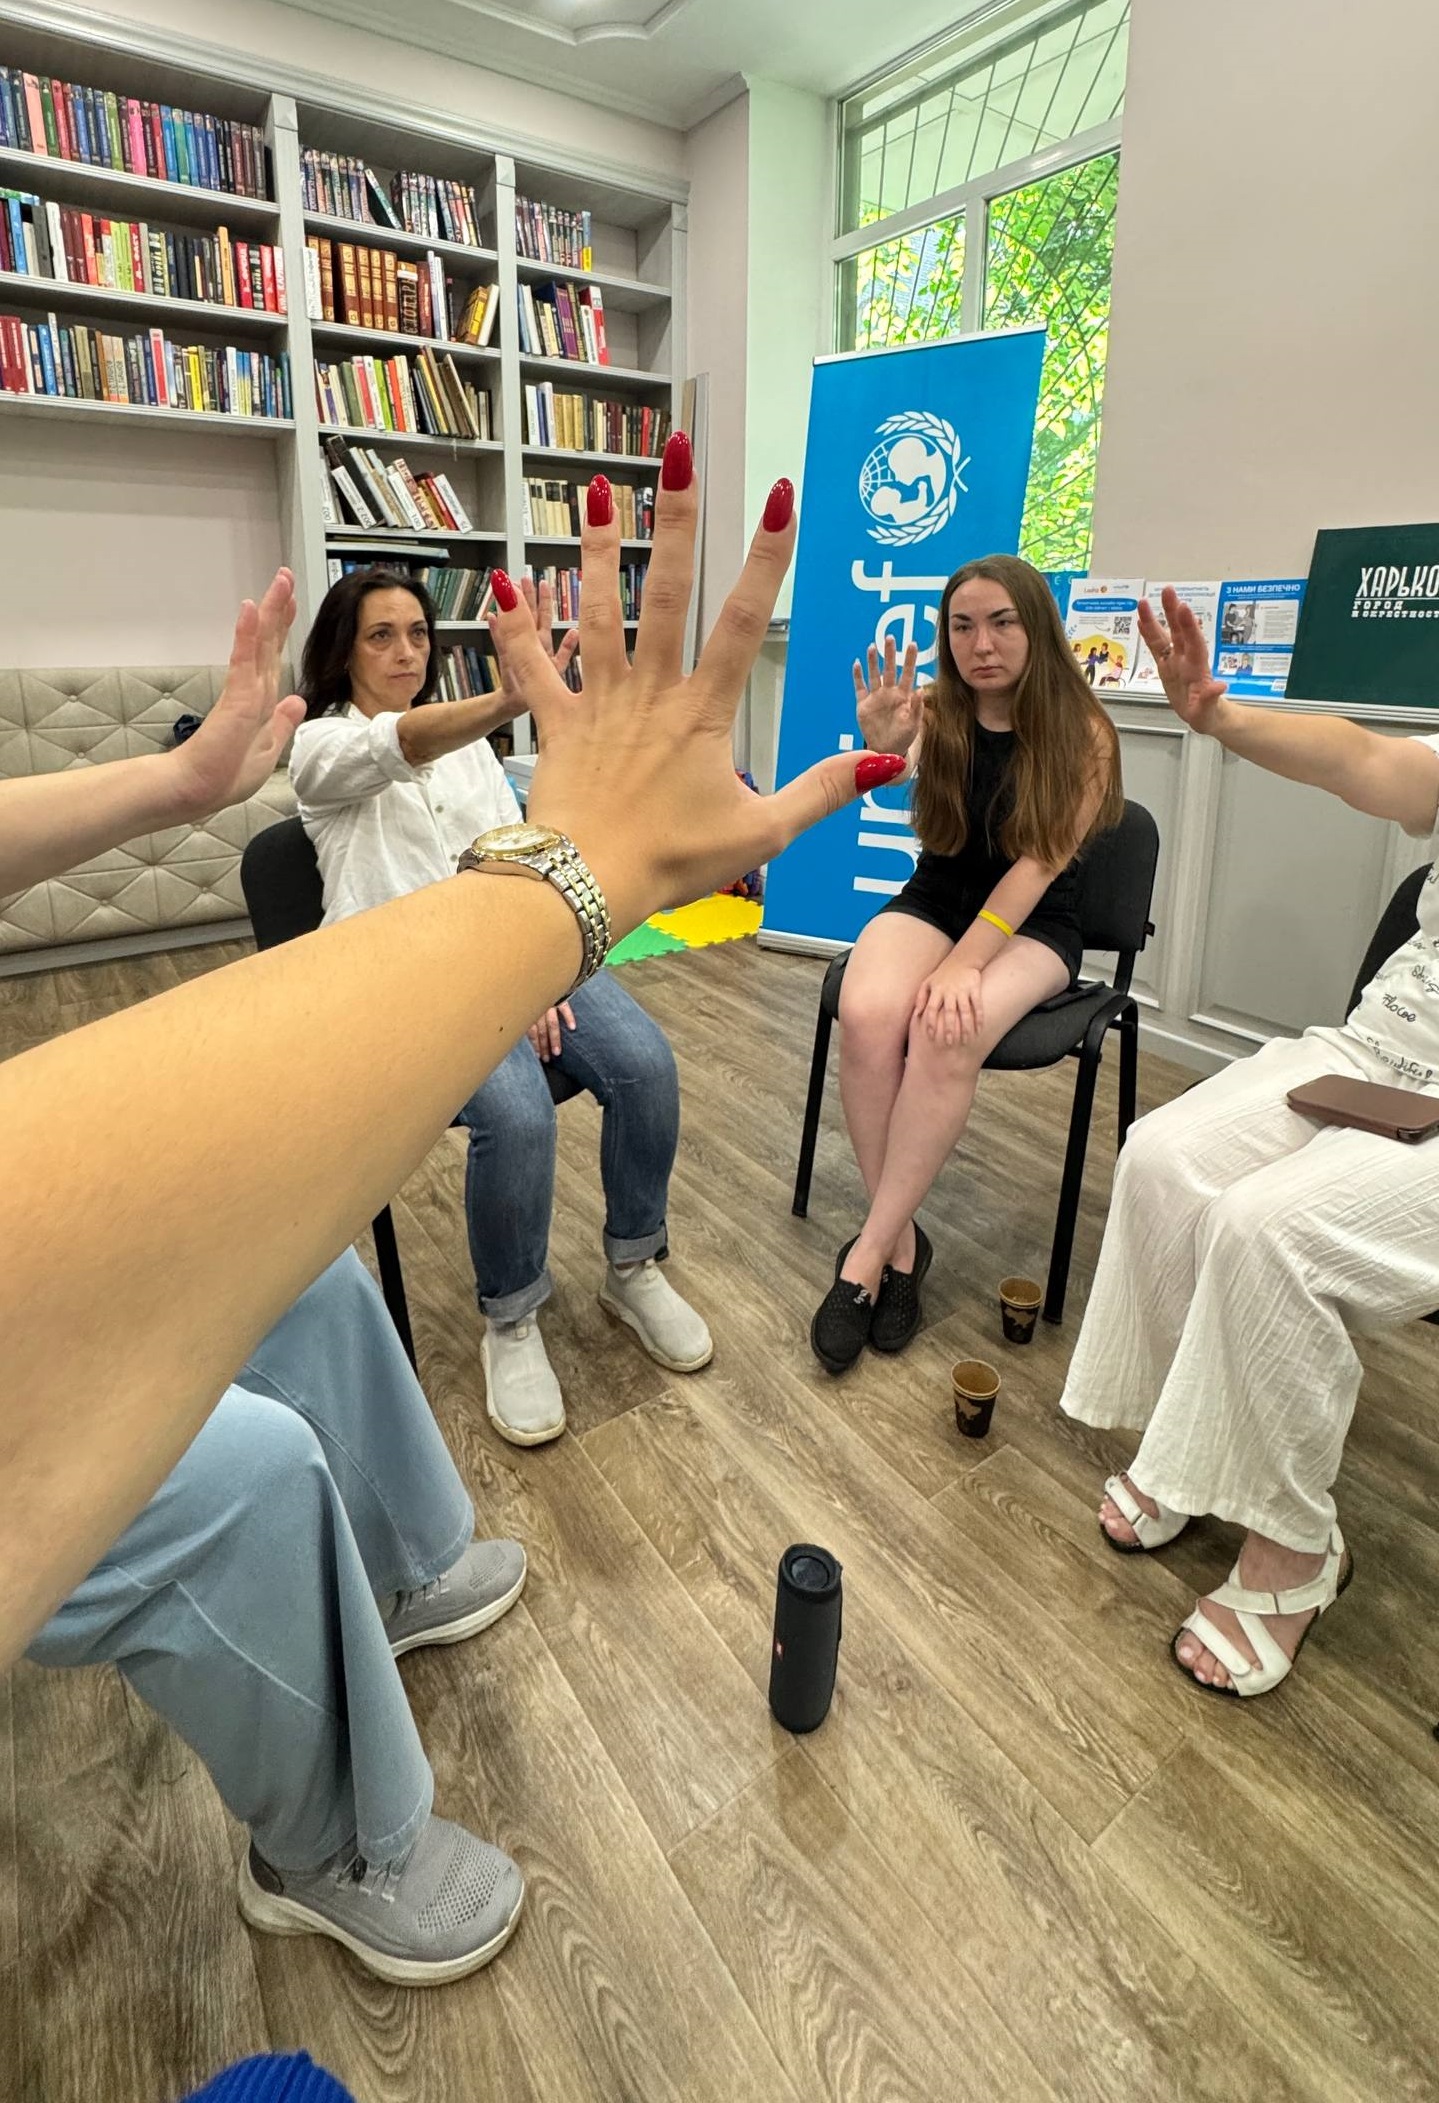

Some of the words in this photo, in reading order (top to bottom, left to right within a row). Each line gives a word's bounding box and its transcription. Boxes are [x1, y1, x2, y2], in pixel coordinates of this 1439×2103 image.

[1355, 564, 1439, 597] ХАРЬКО
[1226, 586, 1232, 594] З
[1232, 585, 1256, 594] НАМИ
[1257, 583, 1301, 593] БЕЗПЕЧНО
[1352, 601, 1404, 610] ГОРОД
